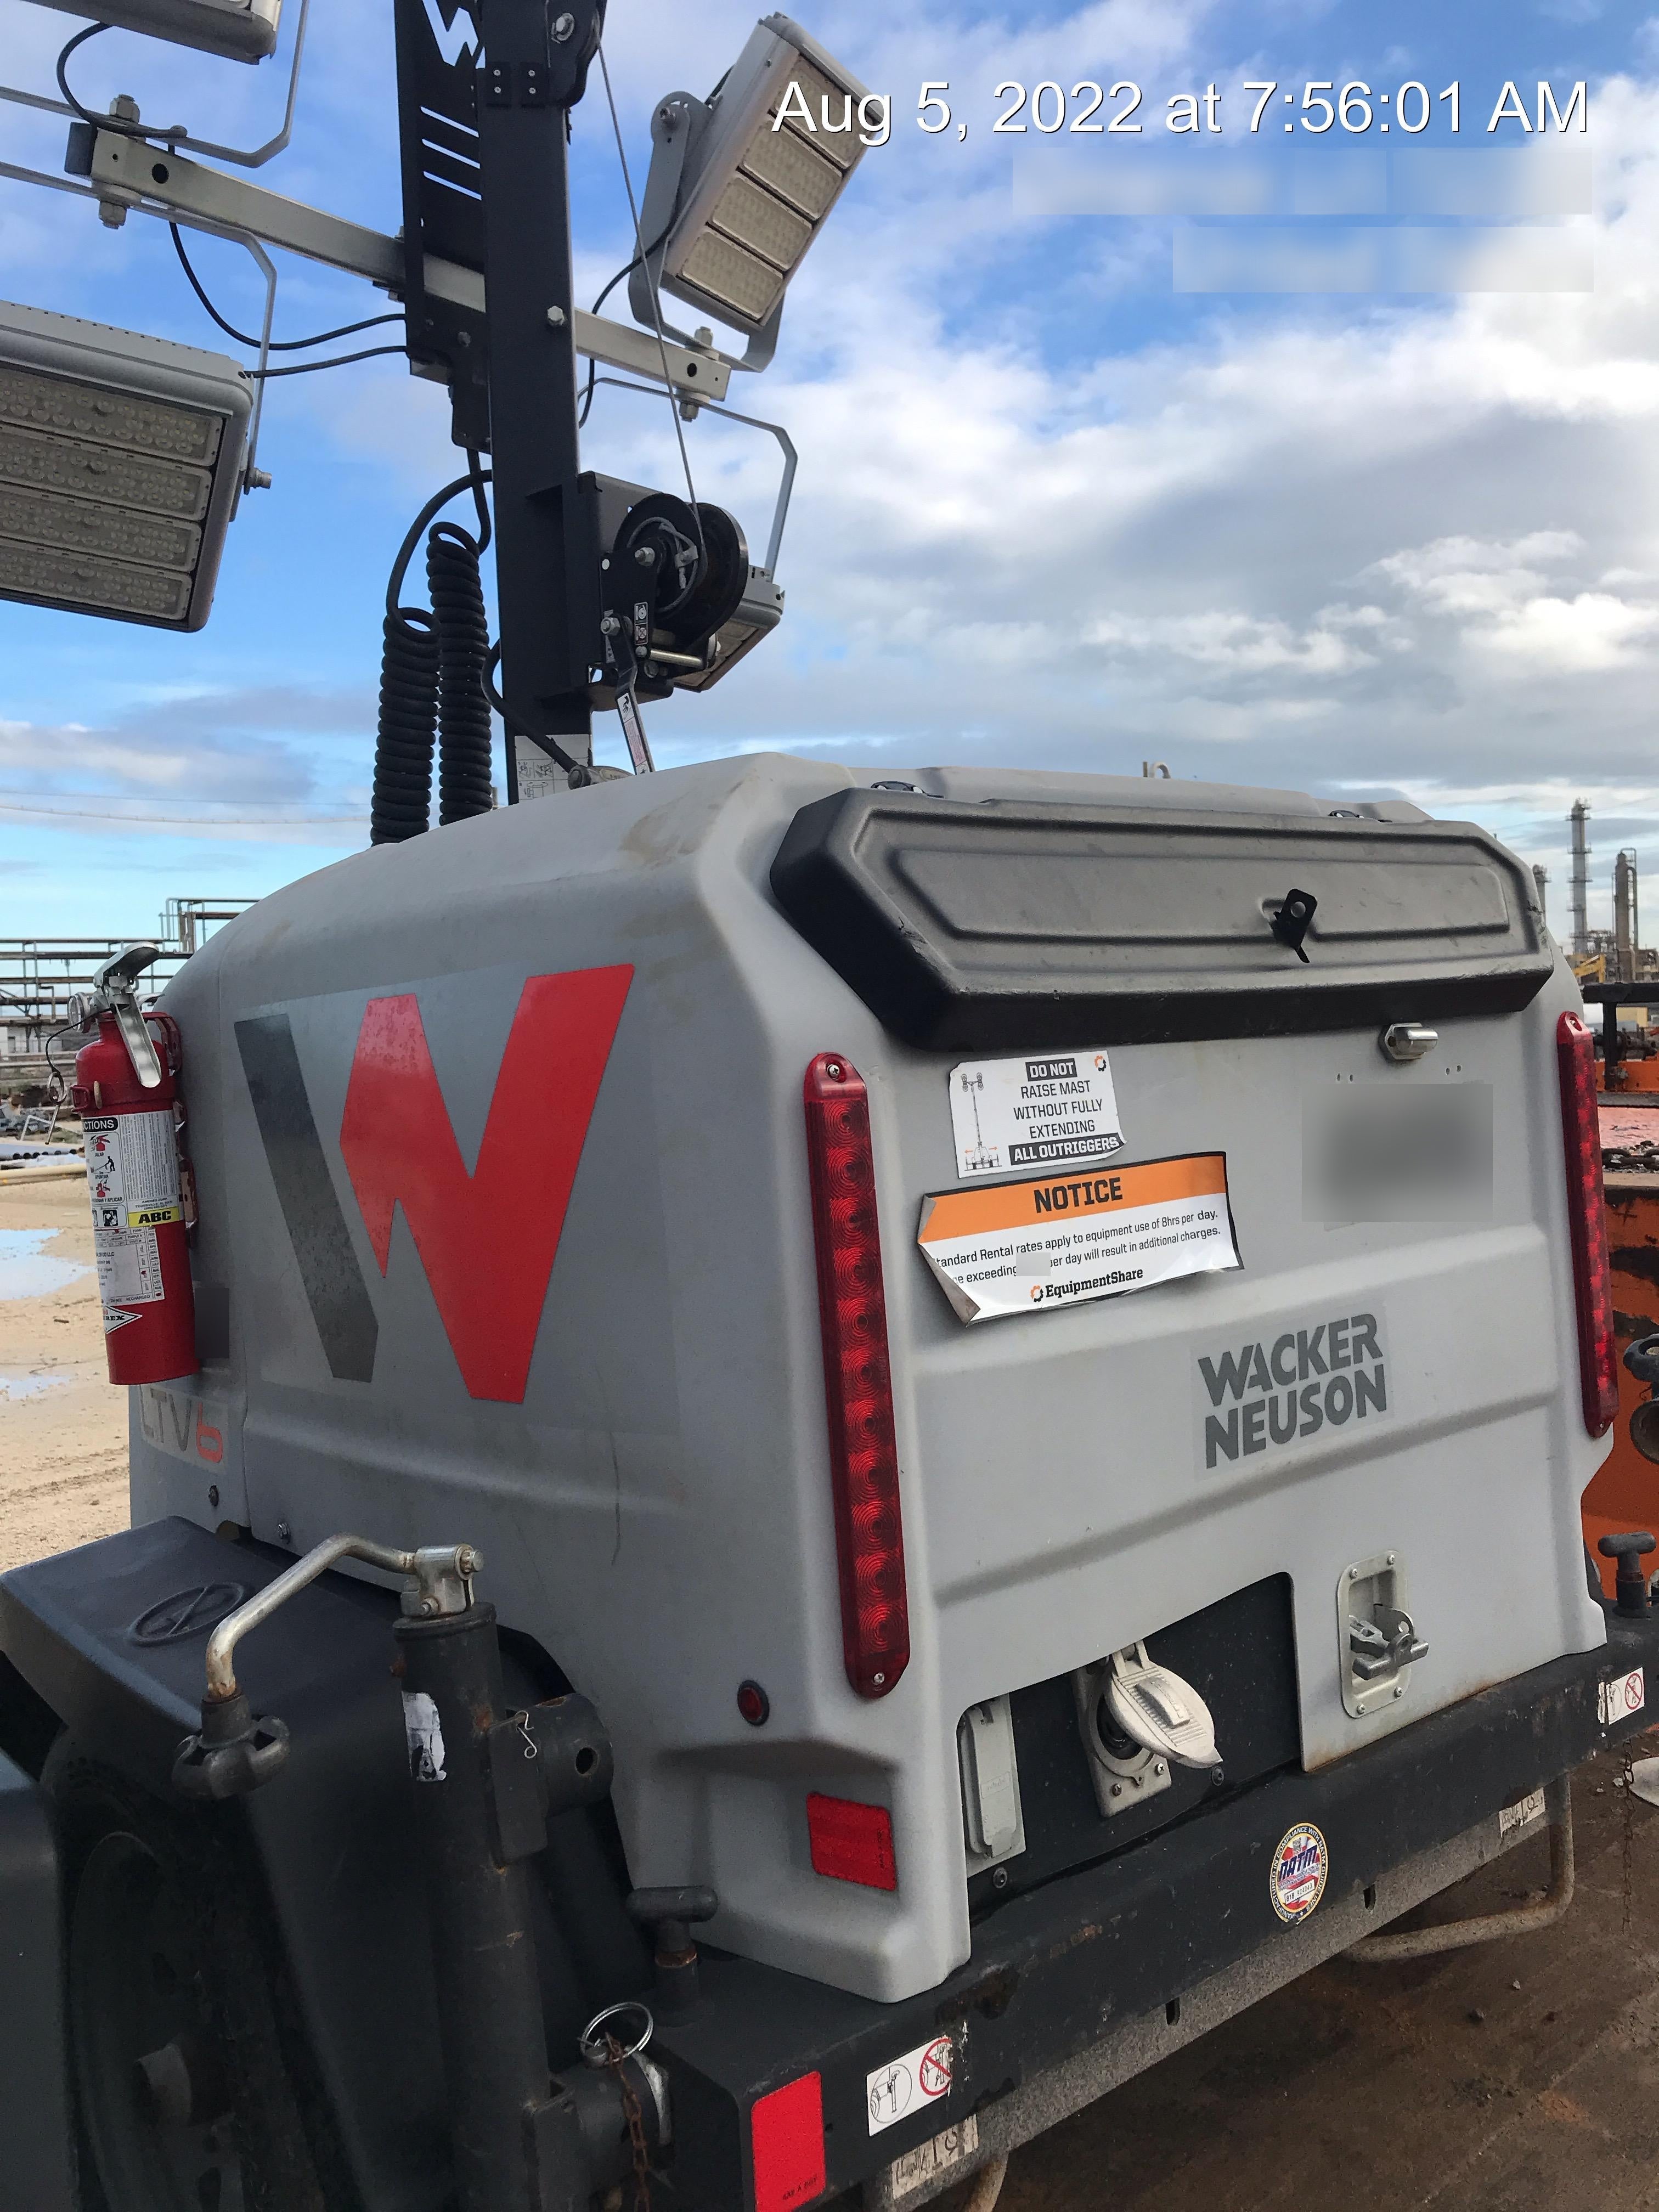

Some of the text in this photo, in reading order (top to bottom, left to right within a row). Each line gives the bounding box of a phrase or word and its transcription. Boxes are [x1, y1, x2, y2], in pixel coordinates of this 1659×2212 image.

[1029, 1062, 1074, 1078] DO NOT
[1020, 1080, 1090, 1099] RAISE MAST
[1013, 1098, 1102, 1120] WITHOUT FULLY
[83, 1119, 114, 1130] CTIONS
[1029, 1119, 1095, 1139] EXTENDING
[1014, 1136, 1120, 1161] ALL OUTRIGGERS
[1034, 1176, 1123, 1214] NOTICE
[138, 1210, 172, 1224] ABC
[936, 1210, 1218, 1267] tandard Rental rates apply to equipment use of 8hrs per day.
[1065, 1253, 1081, 1265] day
[1084, 1248, 1099, 1261] will
[1102, 1244, 1127, 1258] result
[1129, 1242, 1137, 1252] in
[1139, 1233, 1179, 1250] additional
[1180, 1227, 1221, 1242] charges.
[1045, 1268, 1143, 1298] EquipmentShare
[1198, 1313, 1384, 1407] WACKER
[139, 1384, 223, 1463] LTV6
[1205, 1364, 1387, 1469] NEUSON
[1277, 1826, 1308, 1859] COMPLIANCE
[1308, 1827, 1320, 1841] WITH
